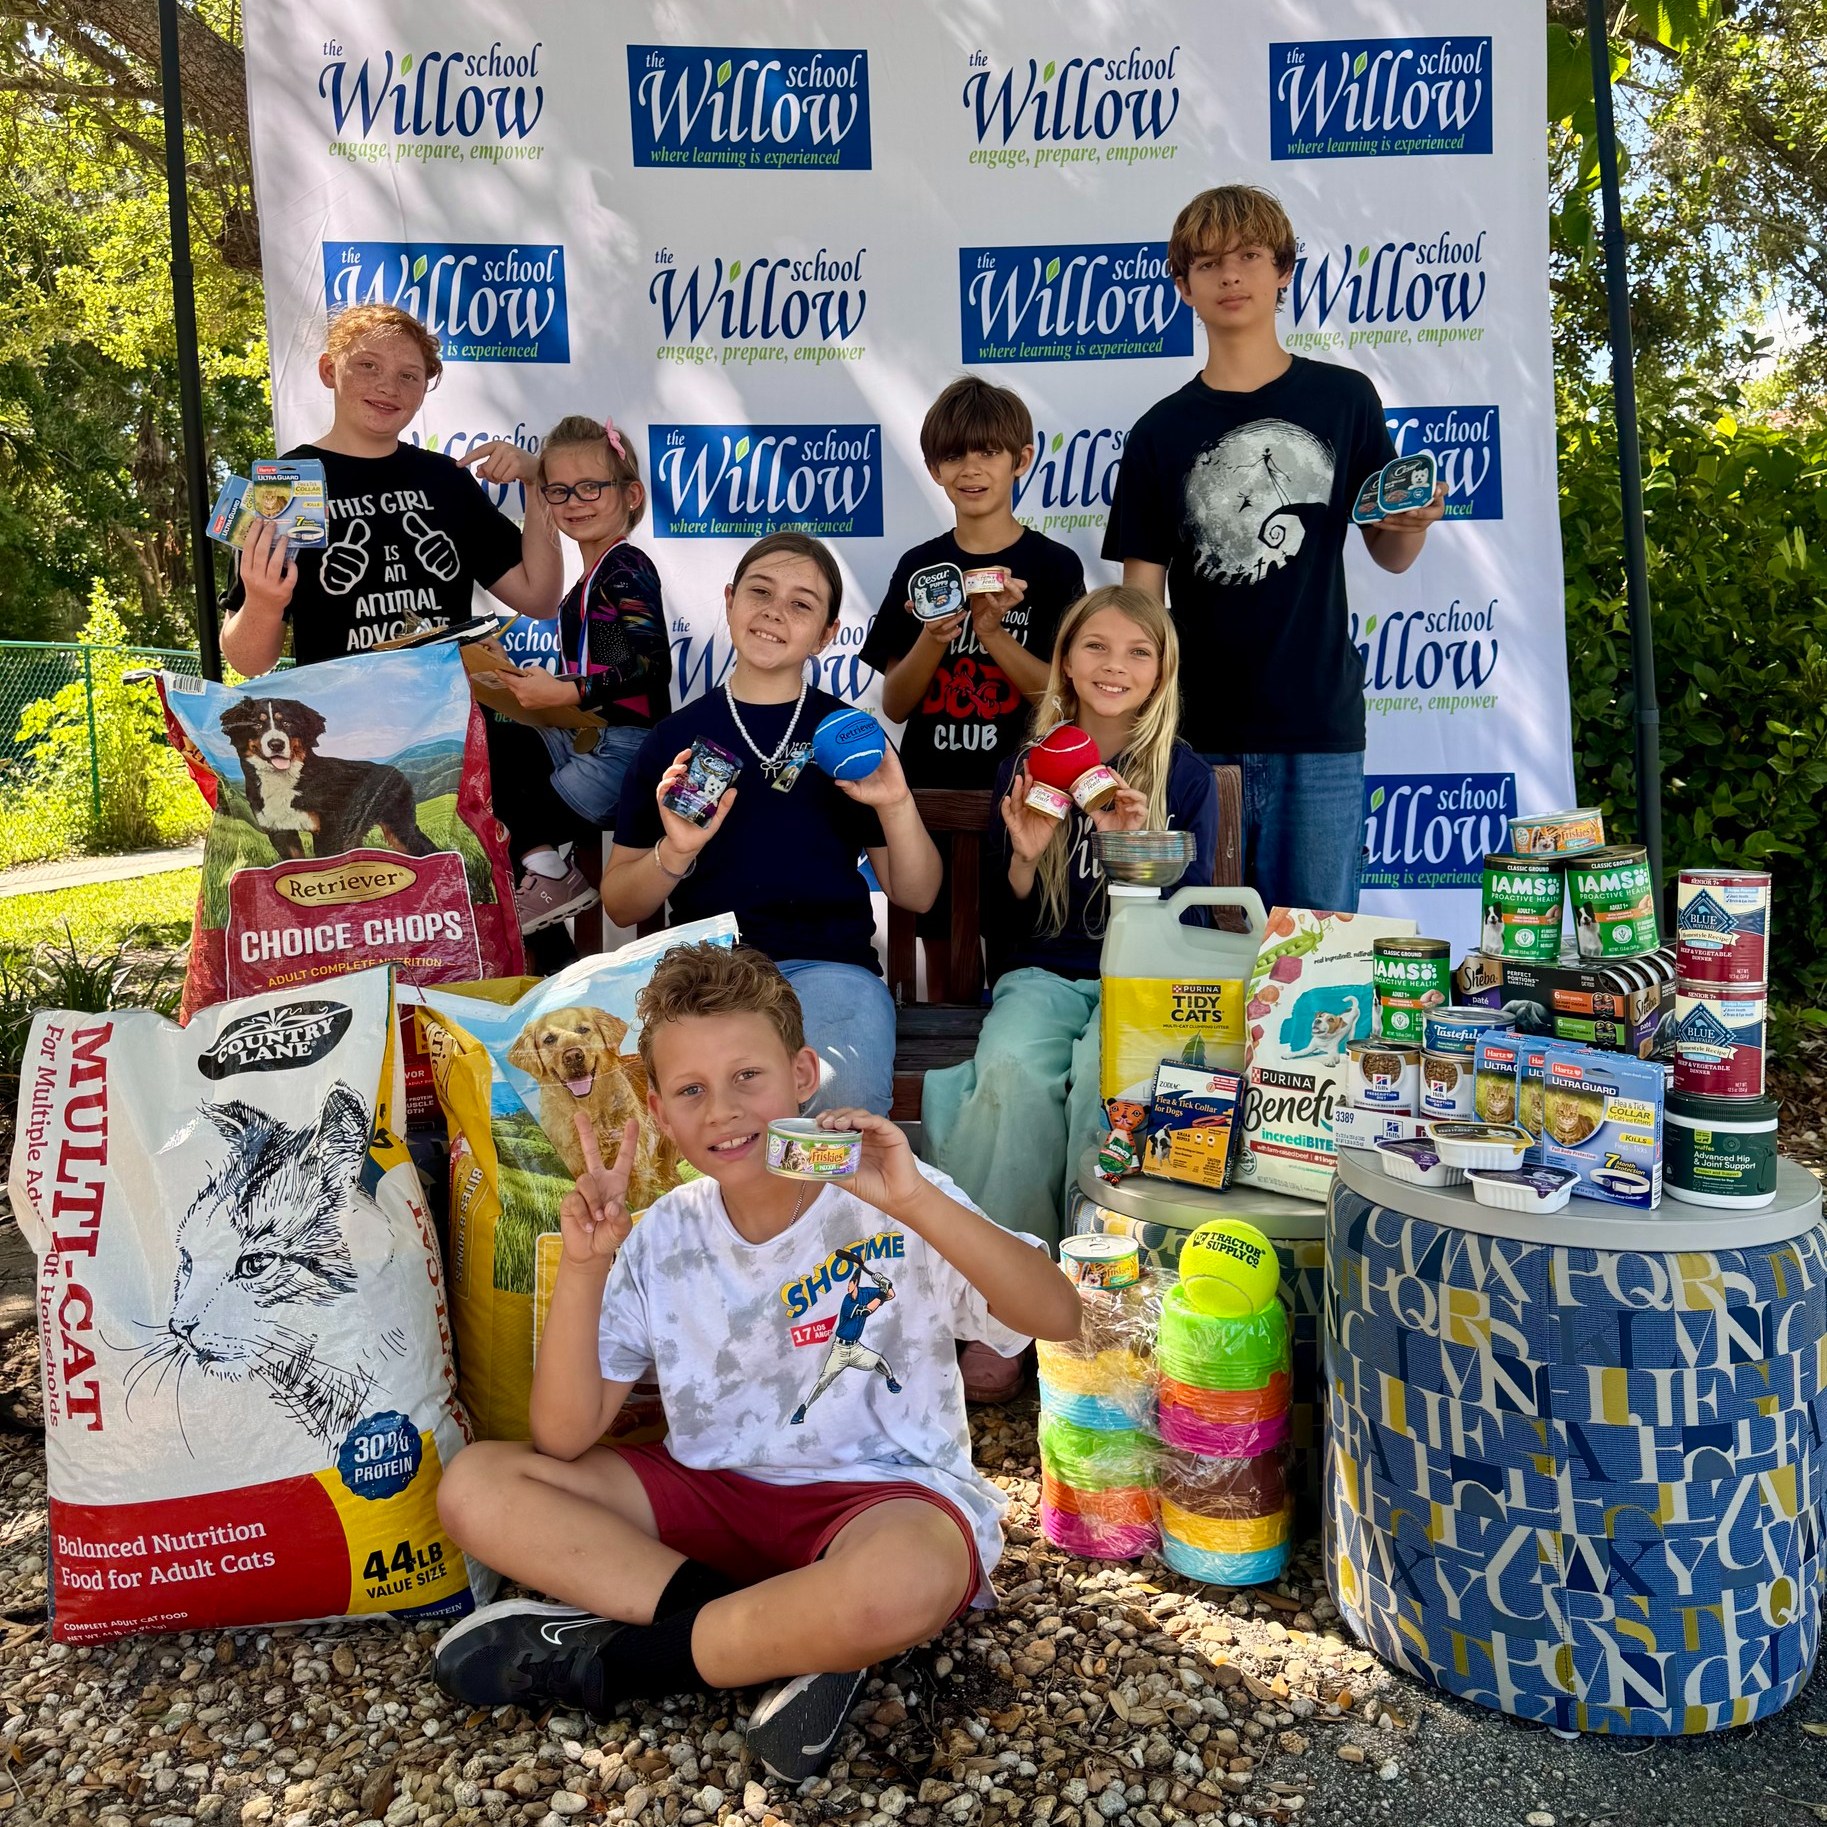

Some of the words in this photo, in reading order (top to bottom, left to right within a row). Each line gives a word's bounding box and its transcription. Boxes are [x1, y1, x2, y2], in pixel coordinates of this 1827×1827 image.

[323, 39, 343, 57] the
[1286, 48, 1306, 65] the
[1417, 41, 1483, 75] school
[465, 42, 542, 77] school
[645, 52, 665, 68] the
[969, 50, 988, 68] the
[1105, 46, 1180, 81] school
[786, 54, 857, 88] school
[319, 50, 543, 140] Willow
[639, 59, 857, 146] Willow
[963, 58, 1180, 146] Willow
[1279, 50, 1482, 138] Willow
[329, 139, 393, 162] engage,
[396, 143, 465, 163] prepare,
[470, 142, 544, 161] empower
[1287, 139, 1323, 154] where
[1327, 138, 1379, 156] learning
[1382, 137, 1391, 152] is
[1395, 135, 1464, 155] experienced
[651, 148, 689, 162] where
[693, 147, 746, 166] learning
[750, 149, 761, 163] is
[765, 149, 840, 168] experienced
[969, 147, 1031, 169] engage,
[1035, 146, 1102, 168] prepare,
[1106, 144, 1178, 165] empower
[341, 247, 360, 264] the
[655, 249, 674, 265] the
[1416, 231, 1486, 264] school
[482, 249, 558, 282] school
[791, 249, 867, 283] school
[977, 253, 996, 270] the
[1283, 242, 1485, 328] Willow
[649, 257, 867, 342] Willow
[969, 255, 1182, 342] Willow
[1286, 331, 1344, 351] engage,
[1349, 329, 1412, 350] prepare,
[1418, 328, 1484, 346] empower
[448, 341, 457, 356] is
[462, 342, 538, 360] experienced
[657, 344, 720, 364] engage,
[723, 346, 791, 365] prepare,
[794, 345, 866, 363] empower
[978, 345, 1016, 359] where
[1020, 342, 1073, 363] learning
[1076, 342, 1087, 356] is
[1090, 338, 1164, 360] experienced
[1423, 410, 1494, 443] school
[667, 430, 684, 446] the
[802, 428, 870, 461] school
[659, 436, 870, 517] Willow
[328, 495, 376, 519] THIS
[380, 491, 434, 512] GIRL
[670, 519, 707, 533] where
[710, 518, 762, 536] learning
[765, 519, 776, 531] is
[779, 518, 853, 534] experienced
[1043, 514, 1107, 533] prepare,
[384, 545, 399, 560] IS
[918, 570, 949, 587] Cesar
[672, 617, 690, 632] the
[1425, 599, 1498, 632] school
[1428, 695, 1498, 714] empower
[839, 722, 876, 742] Retriever
[935, 722, 997, 751] CLUB
[1437, 777, 1510, 811] school
[1561, 827, 1590, 840] Friskies
[1613, 859, 1633, 867] GROUND
[289, 873, 398, 898] Retriever
[1403, 870, 1414, 883] is
[1492, 875, 1546, 896] IAMS
[1578, 871, 1634, 893] IAMS
[1491, 893, 1534, 902] PROACTIVE
[1580, 891, 1623, 899] PROACTIVE
[1690, 914, 1717, 924] BLUE
[241, 923, 353, 963] CHOICE
[364, 911, 462, 946] CHOPS
[1695, 949, 1732, 957] VEGETABLE
[268, 970, 306, 987] ADULT
[311, 959, 375, 977] COMPLETE
[1374, 959, 1420, 980] IAMS
[1463, 966, 1496, 991] Sheba
[1507, 970, 1531, 978] PERFECT
[1173, 996, 1221, 1008] TIDY
[1171, 1010, 1222, 1022] CATS
[46, 1024, 65, 1061] For
[218, 1017, 334, 1064] COUNTRY
[1687, 1027, 1715, 1038] BLUE
[239, 1042, 312, 1065] LANE
[1484, 1061, 1512, 1071] ULTRA
[1555, 1066, 1575, 1075] Hartz
[1692, 1063, 1730, 1071] VEGETABLE
[1159, 1081, 1180, 1089] ZODIAC
[1262, 1071, 1311, 1089] PURINA
[27, 1066, 57, 1161] Multiple
[1156, 1096, 1170, 1105] Flea
[1179, 1099, 1193, 1109] Tick
[1195, 1102, 1217, 1114] Collar
[1166, 1106, 1183, 1118] Dogs
[1609, 1107, 1650, 1119] COLLAR
[1335, 1111, 1354, 1124] 3389
[1262, 1127, 1337, 1152] incrediBITE
[1625, 1135, 1647, 1144] KILLS
[812, 1151, 843, 1162] Friskies
[1605, 1152, 1621, 1168] 7
[1617, 1161, 1636, 1169] Month
[1694, 1151, 1735, 1162] Advanced
[1737, 1155, 1750, 1163] Hip
[1701, 1160, 1722, 1168] Joint
[1724, 1161, 1756, 1170] Support
[460, 1167, 484, 1218] BITES
[52, 1022, 113, 1432] MULTI-CAT
[1206, 1241, 1247, 1261] SUPPLY
[1210, 1232, 1262, 1258] TRACTOR
[793, 1327, 812, 1343] 17
[41, 1285, 58, 1427] Households
[355, 1430, 409, 1463] 30%
[355, 1456, 413, 1483] PROTEIN
[58, 1532, 148, 1560] Balanced
[153, 1521, 266, 1555] Nutrition
[61, 1566, 103, 1591] Food
[108, 1566, 140, 1590] for
[150, 1560, 215, 1586] Adult
[220, 1549, 276, 1574] Cats
[366, 1577, 413, 1599] VALUE
[418, 1563, 447, 1586] SIZE
[64, 1622, 108, 1631] COMPLETE
[111, 1619, 138, 1627] ADULT
[161, 1612, 188, 1620] FOOD
